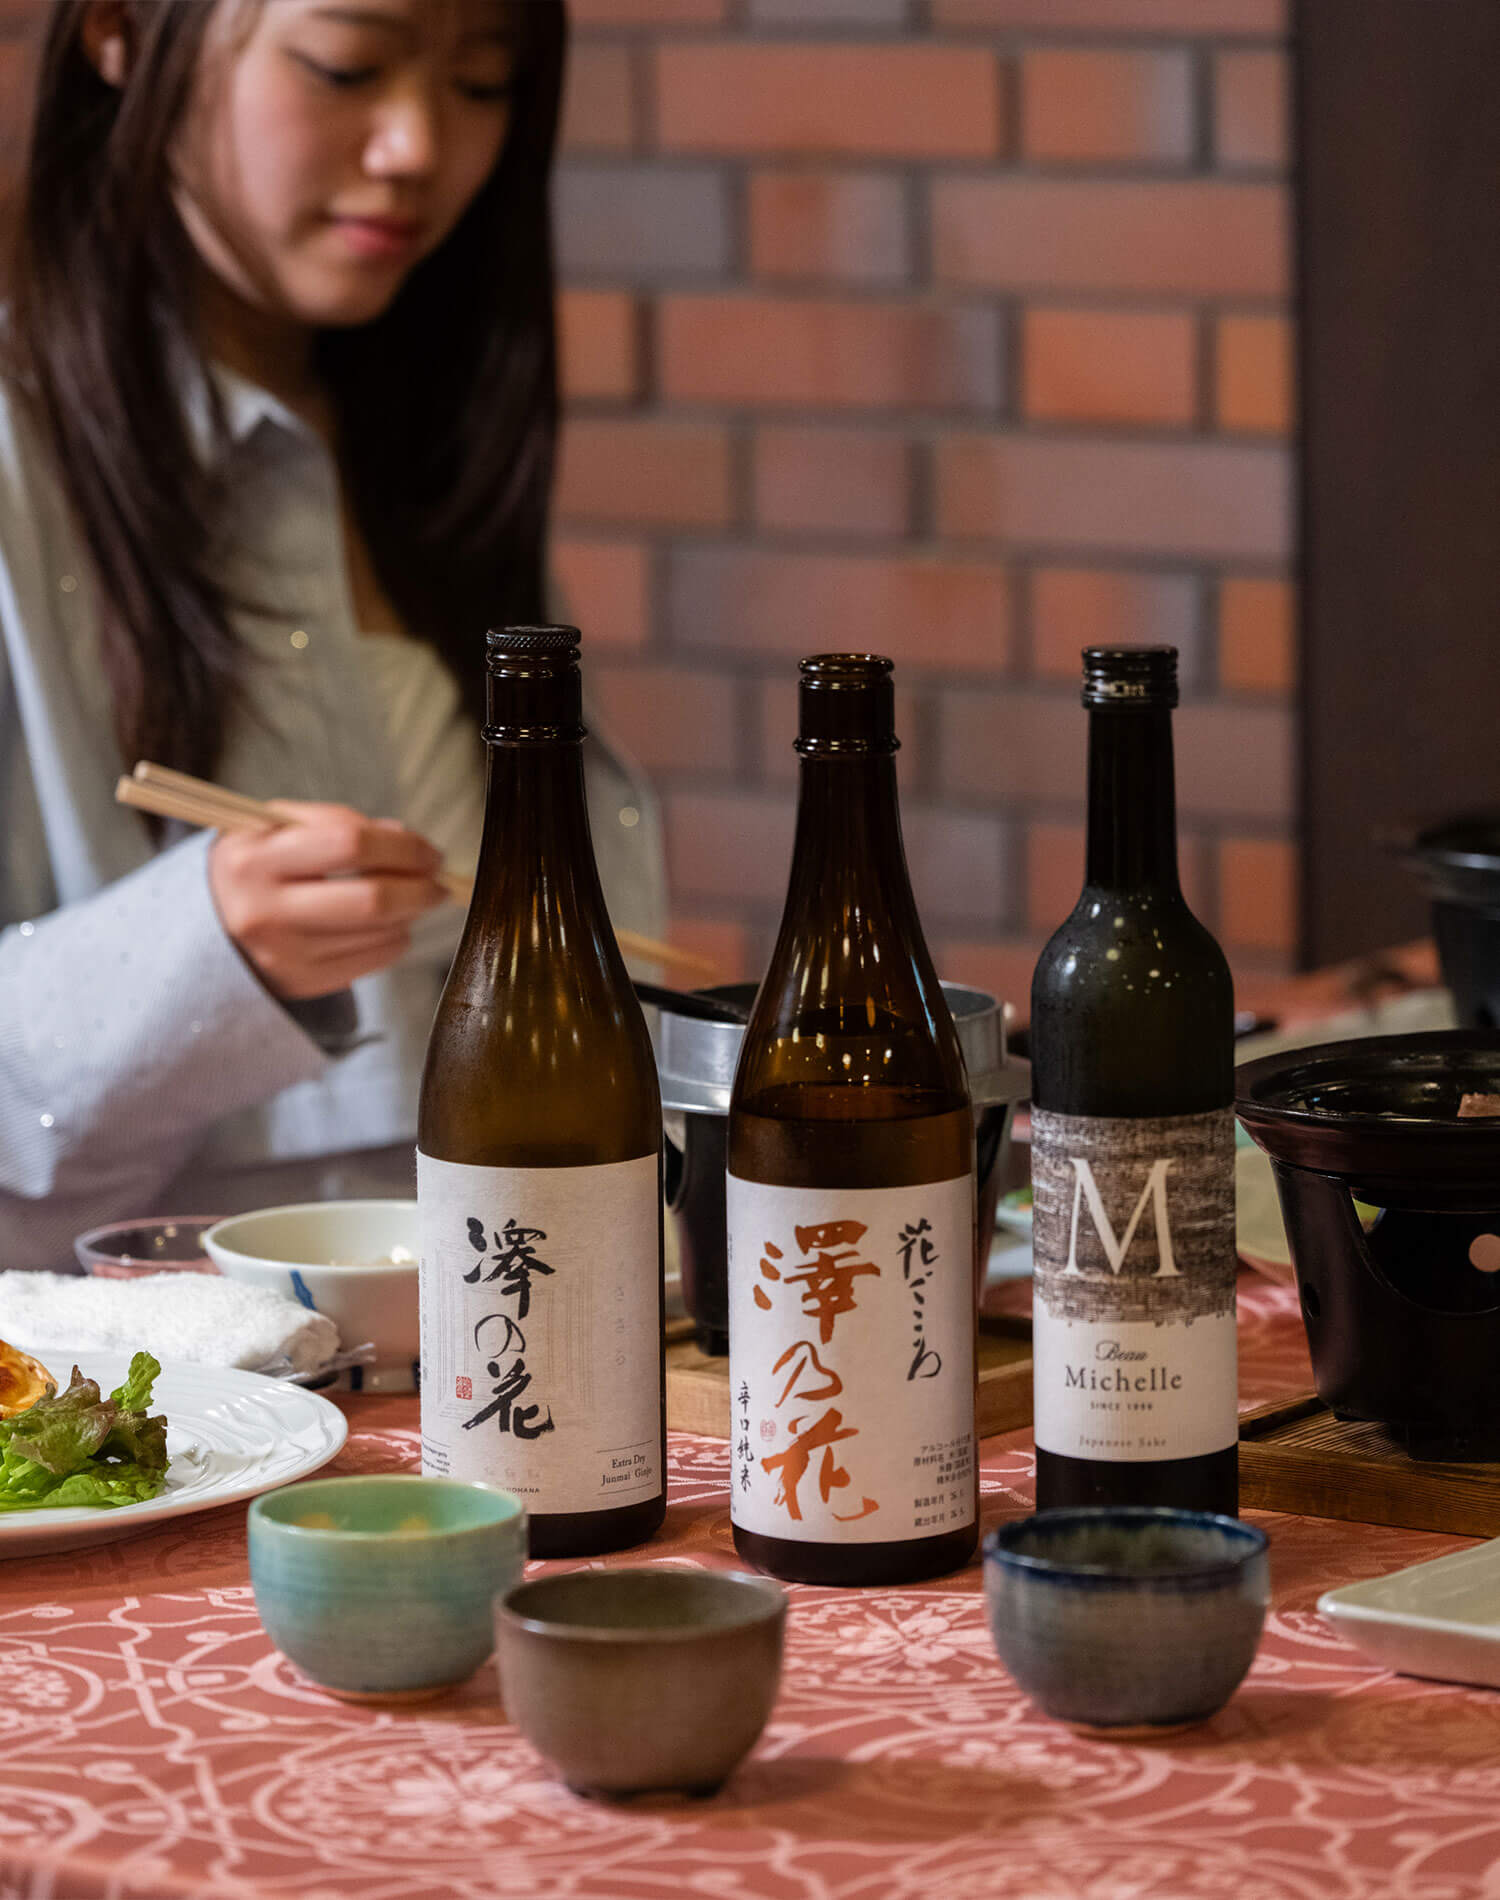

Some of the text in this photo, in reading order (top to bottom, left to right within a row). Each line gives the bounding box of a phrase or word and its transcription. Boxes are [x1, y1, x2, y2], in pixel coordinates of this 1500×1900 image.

[1059, 1158, 1184, 1277] M
[1096, 1341, 1147, 1360] Beau
[1065, 1365, 1182, 1391] Michelle
[737, 1380, 755, 1493] 辛口純米
[612, 1455, 646, 1468] Extra Dry
[601, 1472, 631, 1486] Junmai
